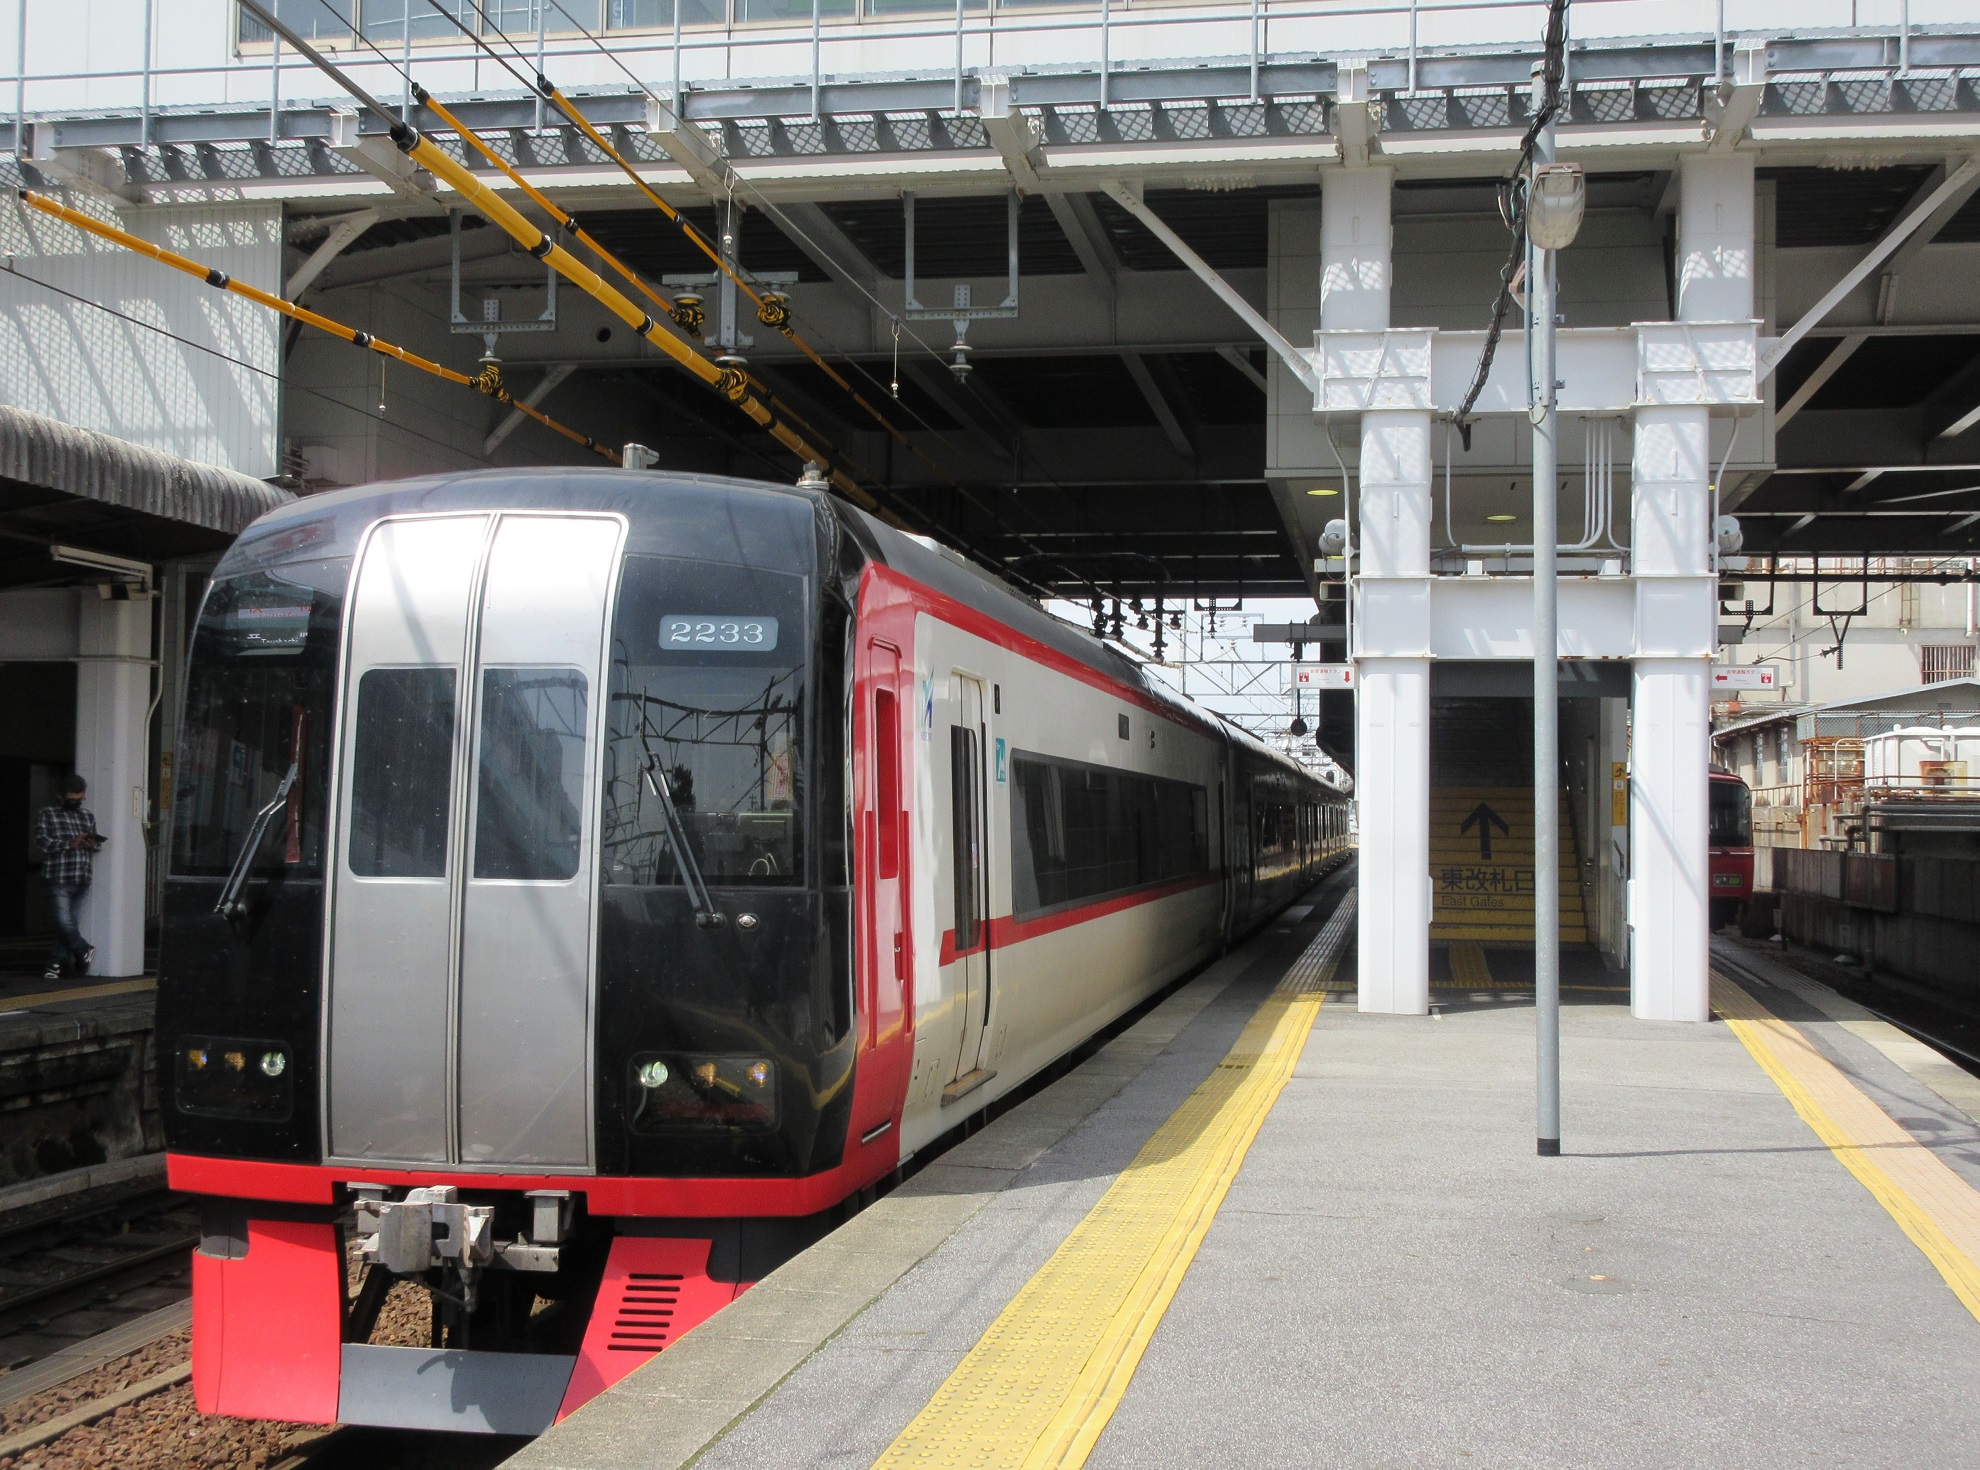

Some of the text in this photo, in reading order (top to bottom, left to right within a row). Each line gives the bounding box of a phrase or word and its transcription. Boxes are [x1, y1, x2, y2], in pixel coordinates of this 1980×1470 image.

[670, 622, 763, 643] 2233
[1441, 867, 1535, 892] 東改札口
[1441, 895, 1504, 908] East Gates
